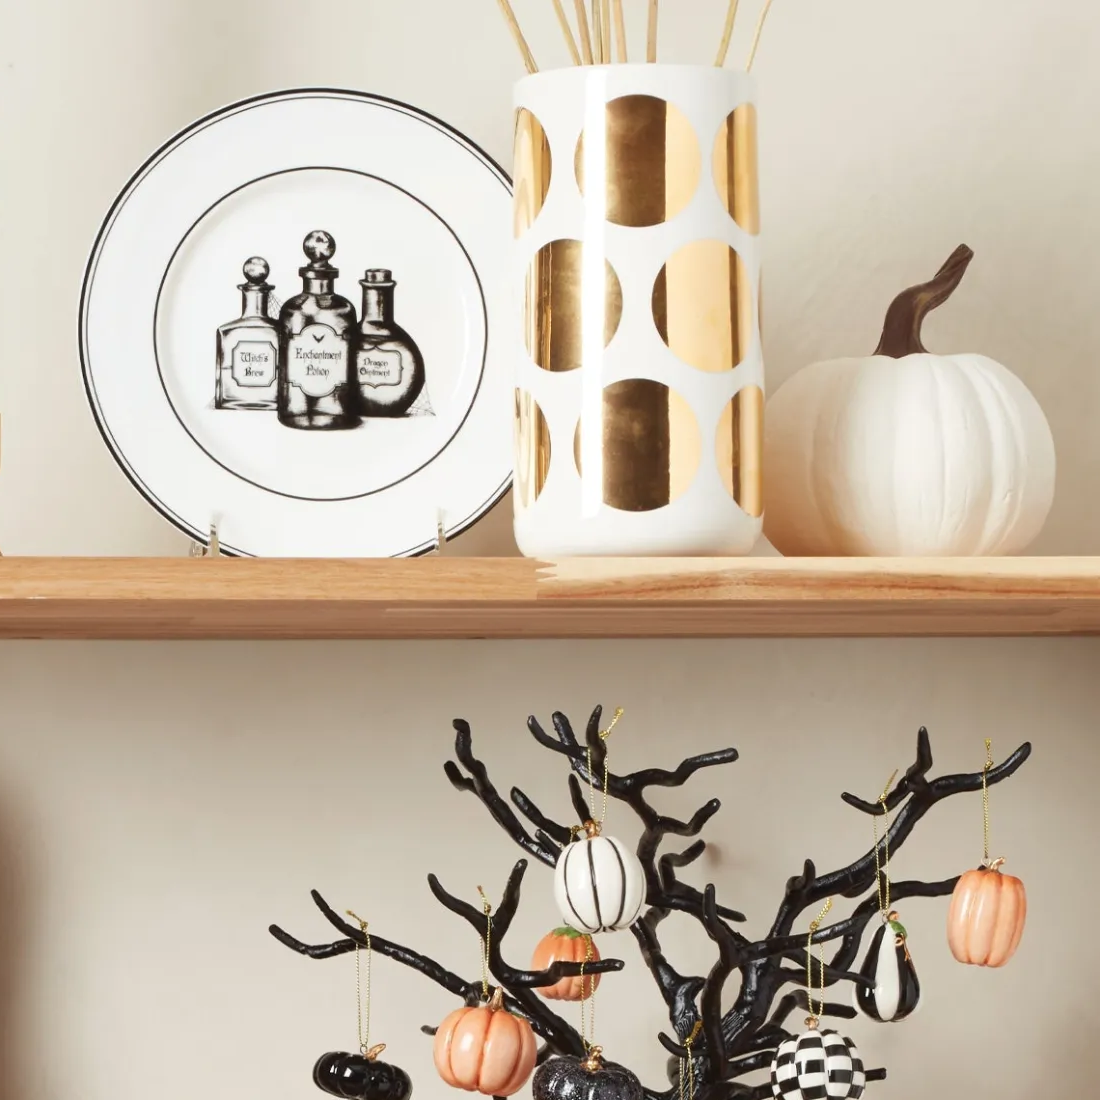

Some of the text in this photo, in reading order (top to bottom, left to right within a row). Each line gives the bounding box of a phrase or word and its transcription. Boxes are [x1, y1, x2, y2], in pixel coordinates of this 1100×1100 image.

[295, 348, 342, 363] Enchantment
[363, 358, 389, 369] Dragon
[244, 367, 264, 377] Brew
[306, 364, 330, 379] Potion
[360, 367, 391, 378] Ointment
